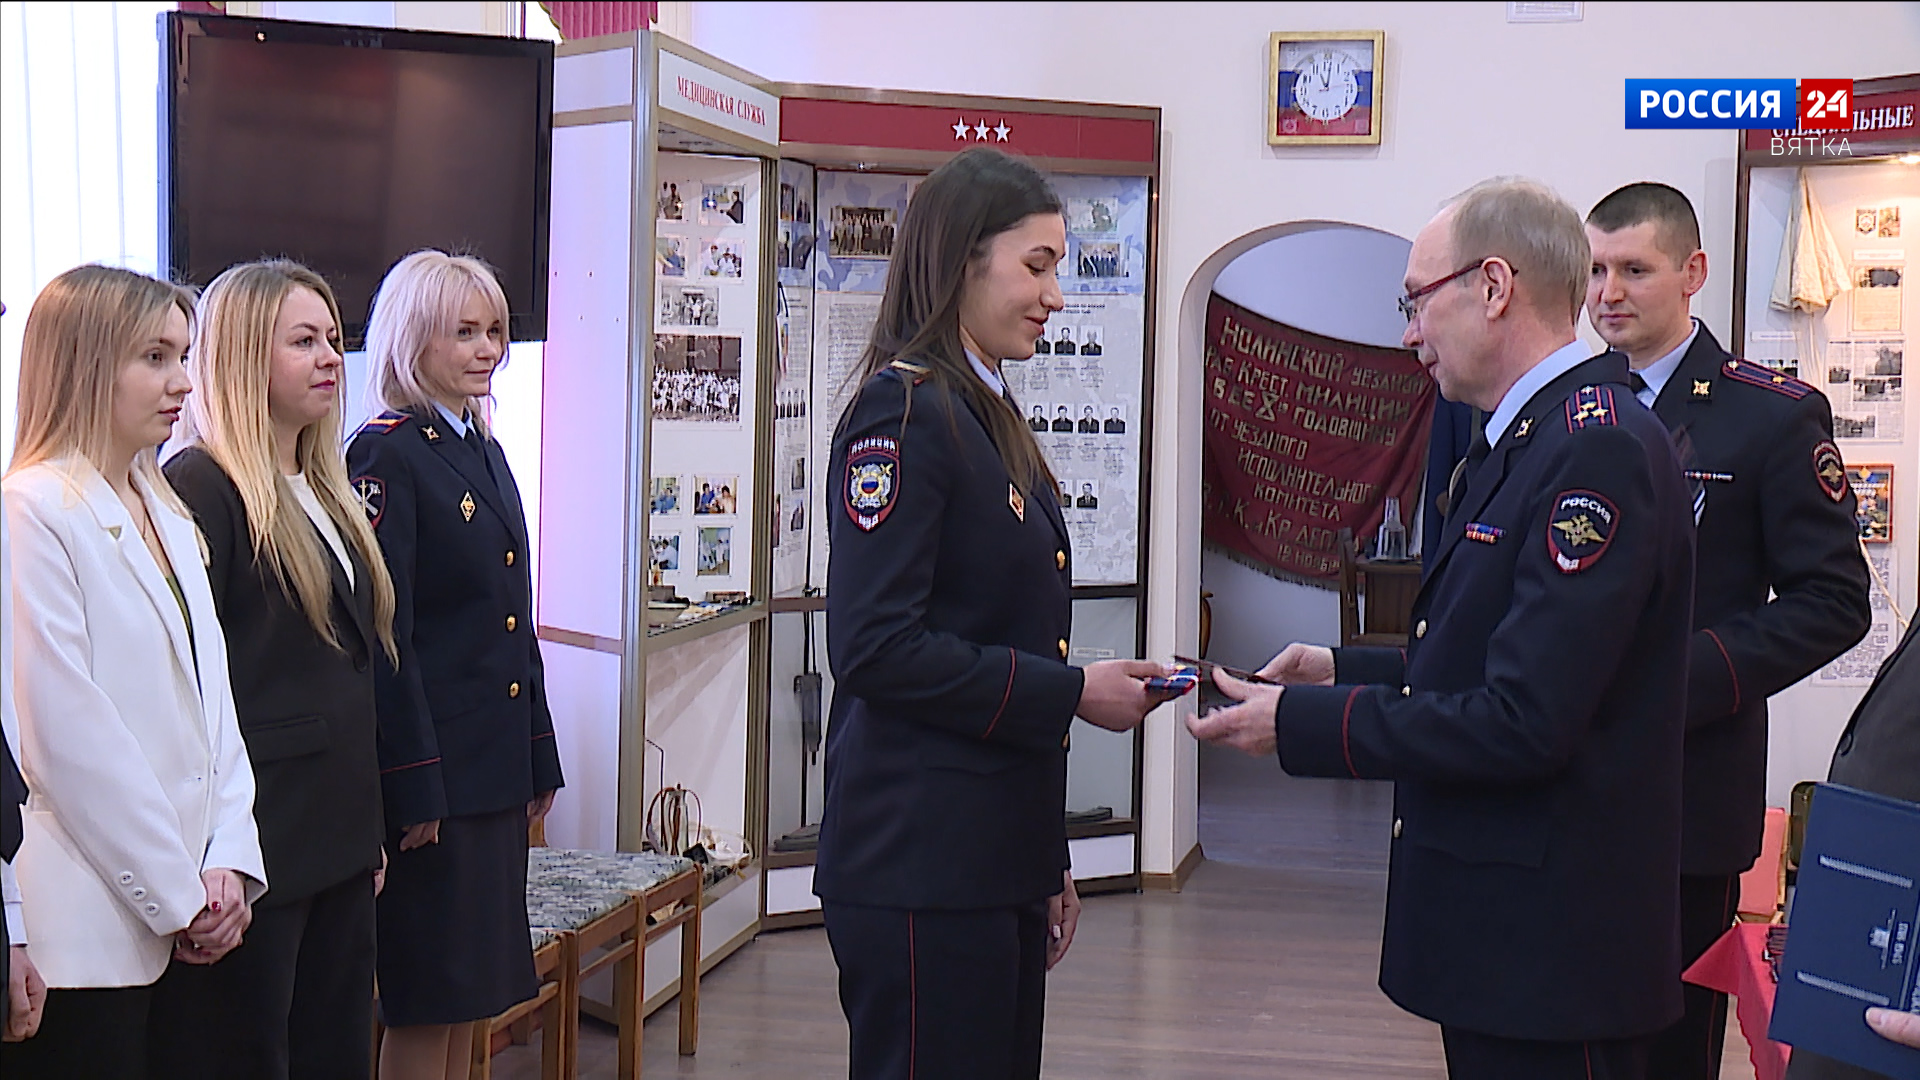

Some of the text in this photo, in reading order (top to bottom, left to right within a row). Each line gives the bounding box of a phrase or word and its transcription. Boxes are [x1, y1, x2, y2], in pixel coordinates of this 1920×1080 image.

[677, 75, 766, 127] МЕДИЦИНСКАЯ СЛУЖБА
[1213, 377, 1227, 400] В
[851, 437, 897, 456] ПОЛИЦИЯ
[1254, 481, 1342, 522] КОМИТЕТА
[1560, 497, 1612, 525] РОССИЯ
